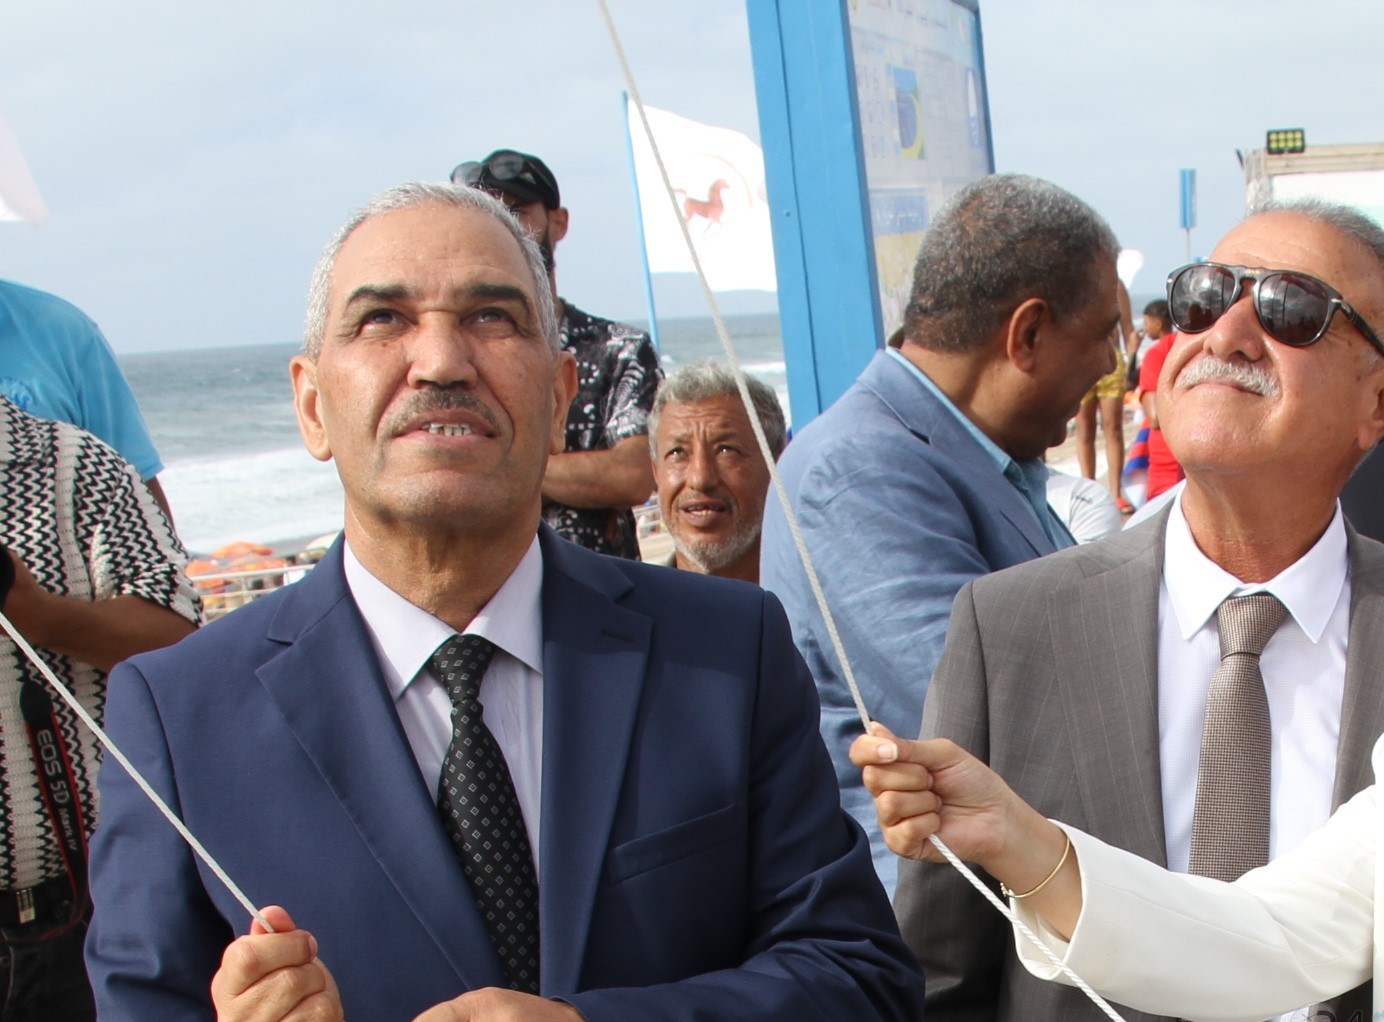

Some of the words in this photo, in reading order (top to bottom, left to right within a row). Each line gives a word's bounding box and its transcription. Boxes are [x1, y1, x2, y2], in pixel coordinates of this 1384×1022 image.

[37, 729, 62, 776] EOS
[51, 780, 70, 804] 5D
[59, 807, 74, 838] Mark
